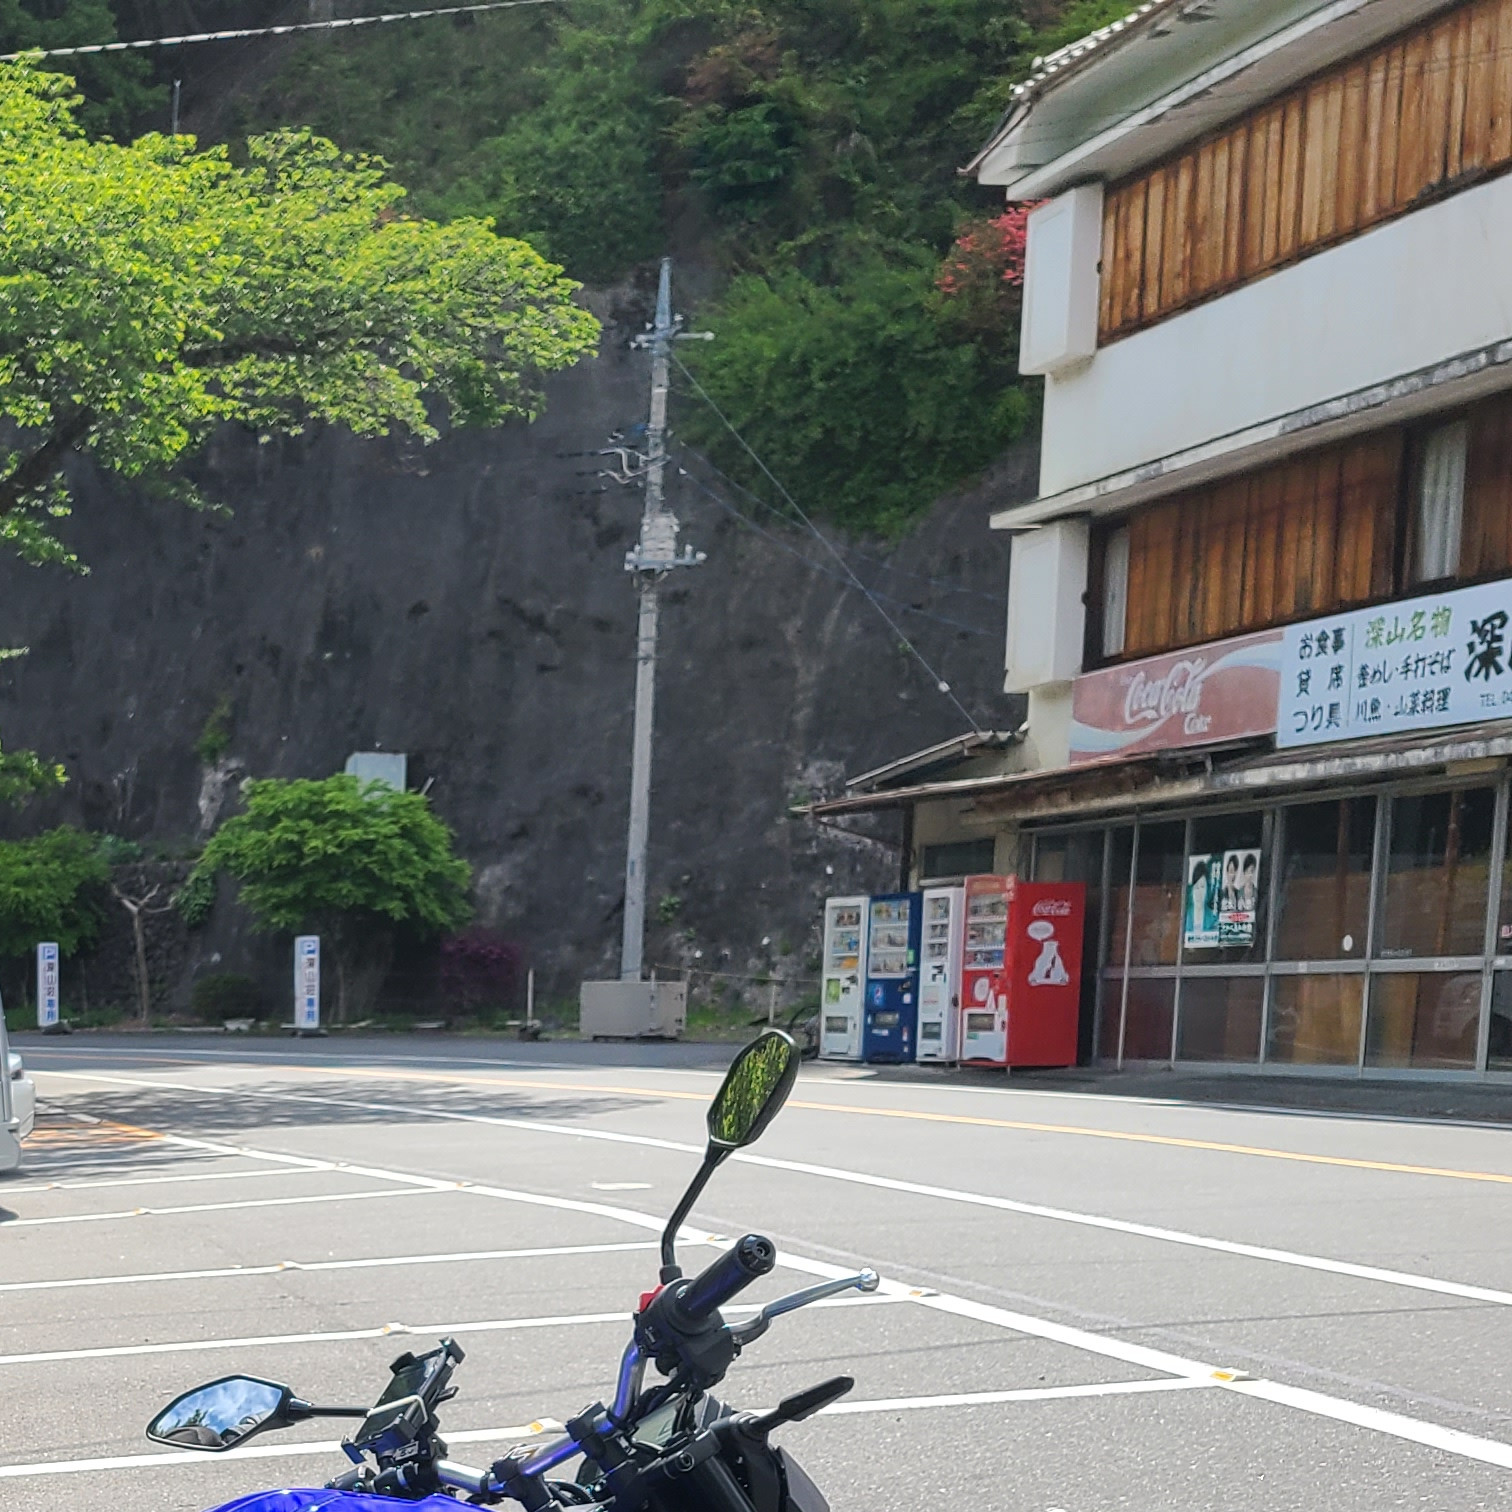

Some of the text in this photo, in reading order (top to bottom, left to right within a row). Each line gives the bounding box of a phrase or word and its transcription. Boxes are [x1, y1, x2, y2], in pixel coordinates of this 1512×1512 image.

[1299, 626, 1346, 660] お食事
[1365, 605, 1453, 648] 深山名物
[1464, 610, 1512, 683] 深
[1292, 702, 1342, 733] つり具
